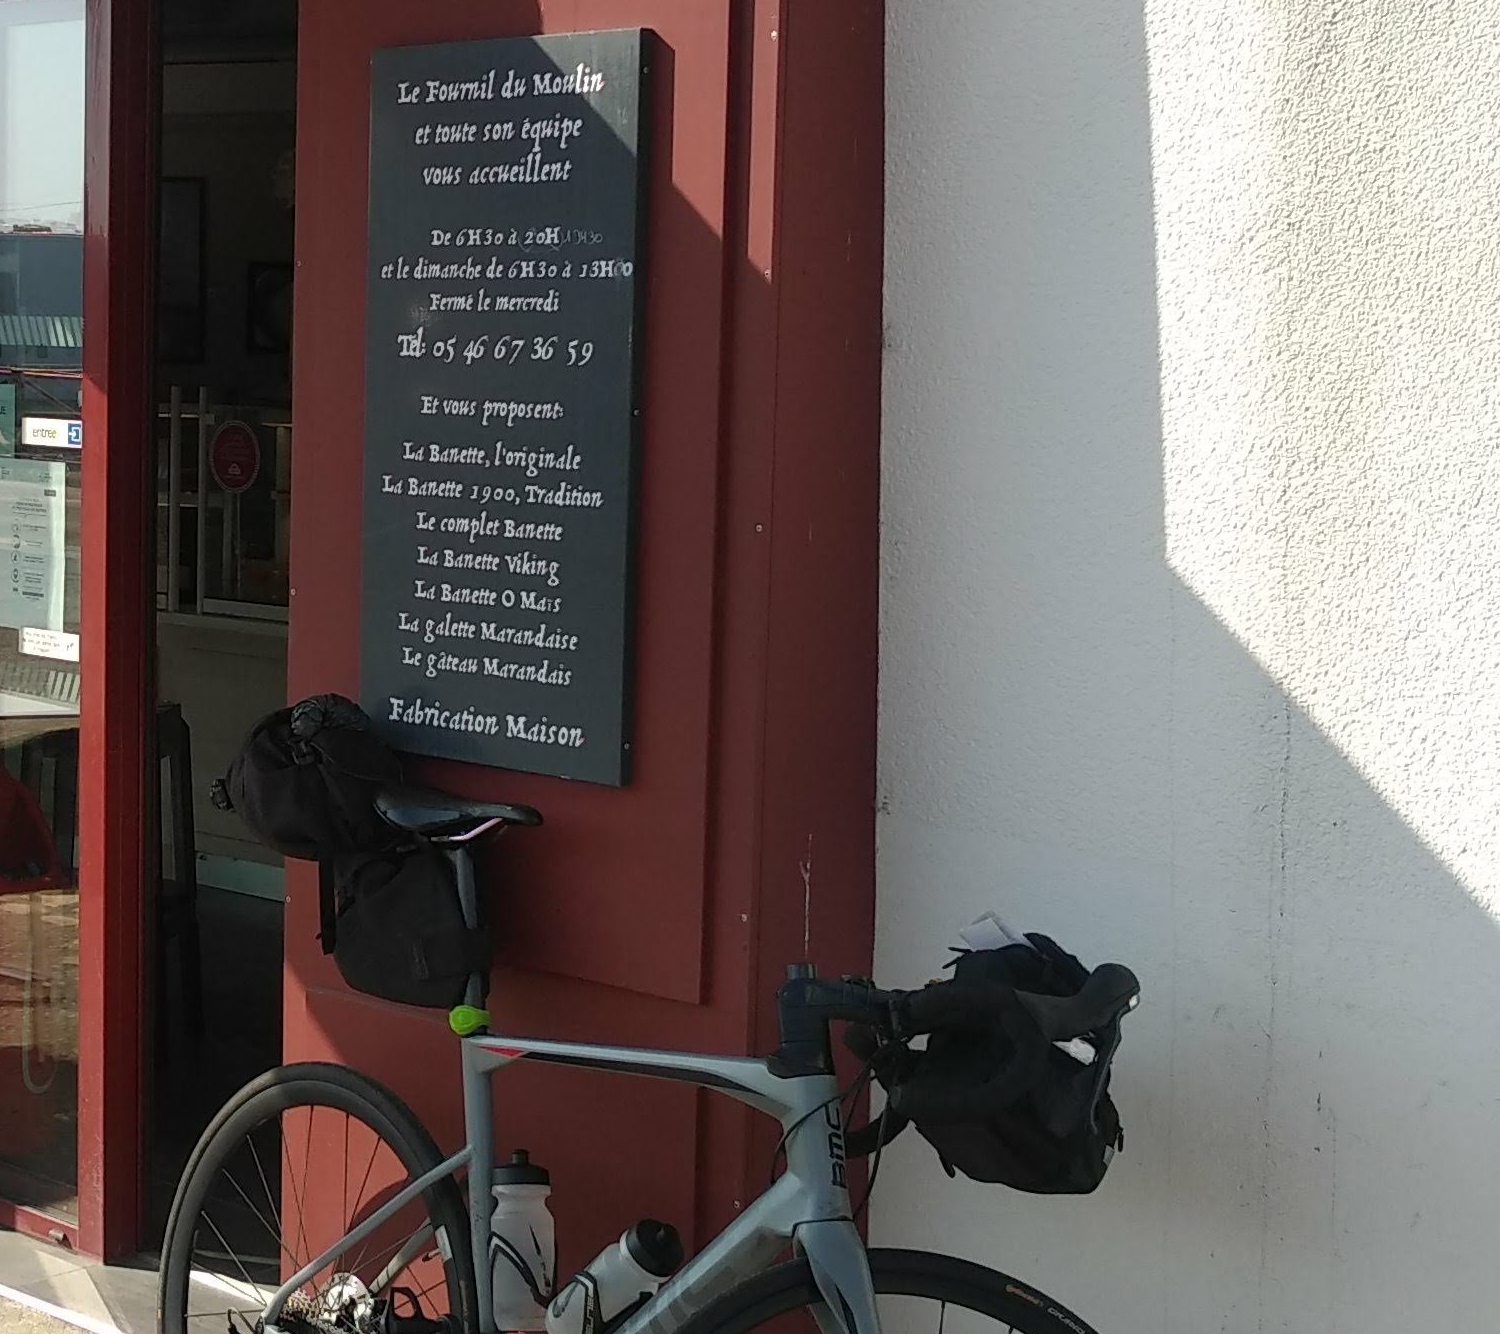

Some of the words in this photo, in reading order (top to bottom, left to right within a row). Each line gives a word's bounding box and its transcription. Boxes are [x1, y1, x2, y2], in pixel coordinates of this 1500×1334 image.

[398, 81, 420, 103] Le
[426, 70, 494, 103] Fournil
[501, 71, 526, 98] du
[533, 63, 604, 96] Moulin
[415, 125, 429, 145] et
[435, 122, 477, 143] toute
[482, 122, 515, 141] son
[521, 113, 583, 151] équipe
[423, 166, 462, 185] vous
[469, 153, 572, 184] accueillent
[431, 229, 451, 246] De
[508, 227, 517, 245] à
[381, 262, 394, 279] et
[397, 257, 411, 279] le
[413, 258, 481, 280] dimanche
[486, 259, 503, 278] de
[562, 260, 571, 278] à
[477, 289, 491, 311] le
[495, 292, 559, 311] mercredi
[433, 338, 456, 362] 05
[463, 336, 484, 365] 46
[494, 337, 524, 364] 67
[531, 337, 557, 360] 36
[567, 340, 593, 365] 59
[421, 396, 438, 415] Et
[443, 398, 476, 417] vous
[403, 442, 424, 461] La
[382, 476, 402, 494] La
[408, 478, 463, 498] Banette
[525, 483, 603, 507] Tradition
[416, 512, 436, 530] Le
[440, 511, 499, 543] complet
[503, 520, 563, 541] Banette
[417, 546, 438, 565] La
[443, 550, 499, 571] Banette
[505, 551, 560, 586] Viking
[415, 581, 435, 599] La
[441, 584, 496, 606] Banette
[399, 613, 419, 632] La
[425, 614, 475, 642] galette
[481, 622, 578, 650] Marandaise
[402, 647, 421, 665] Le
[427, 651, 477, 677] gâteau
[483, 657, 572, 686] Marandais
[389, 697, 499, 734] Fabrication
[506, 715, 584, 748] Maison
